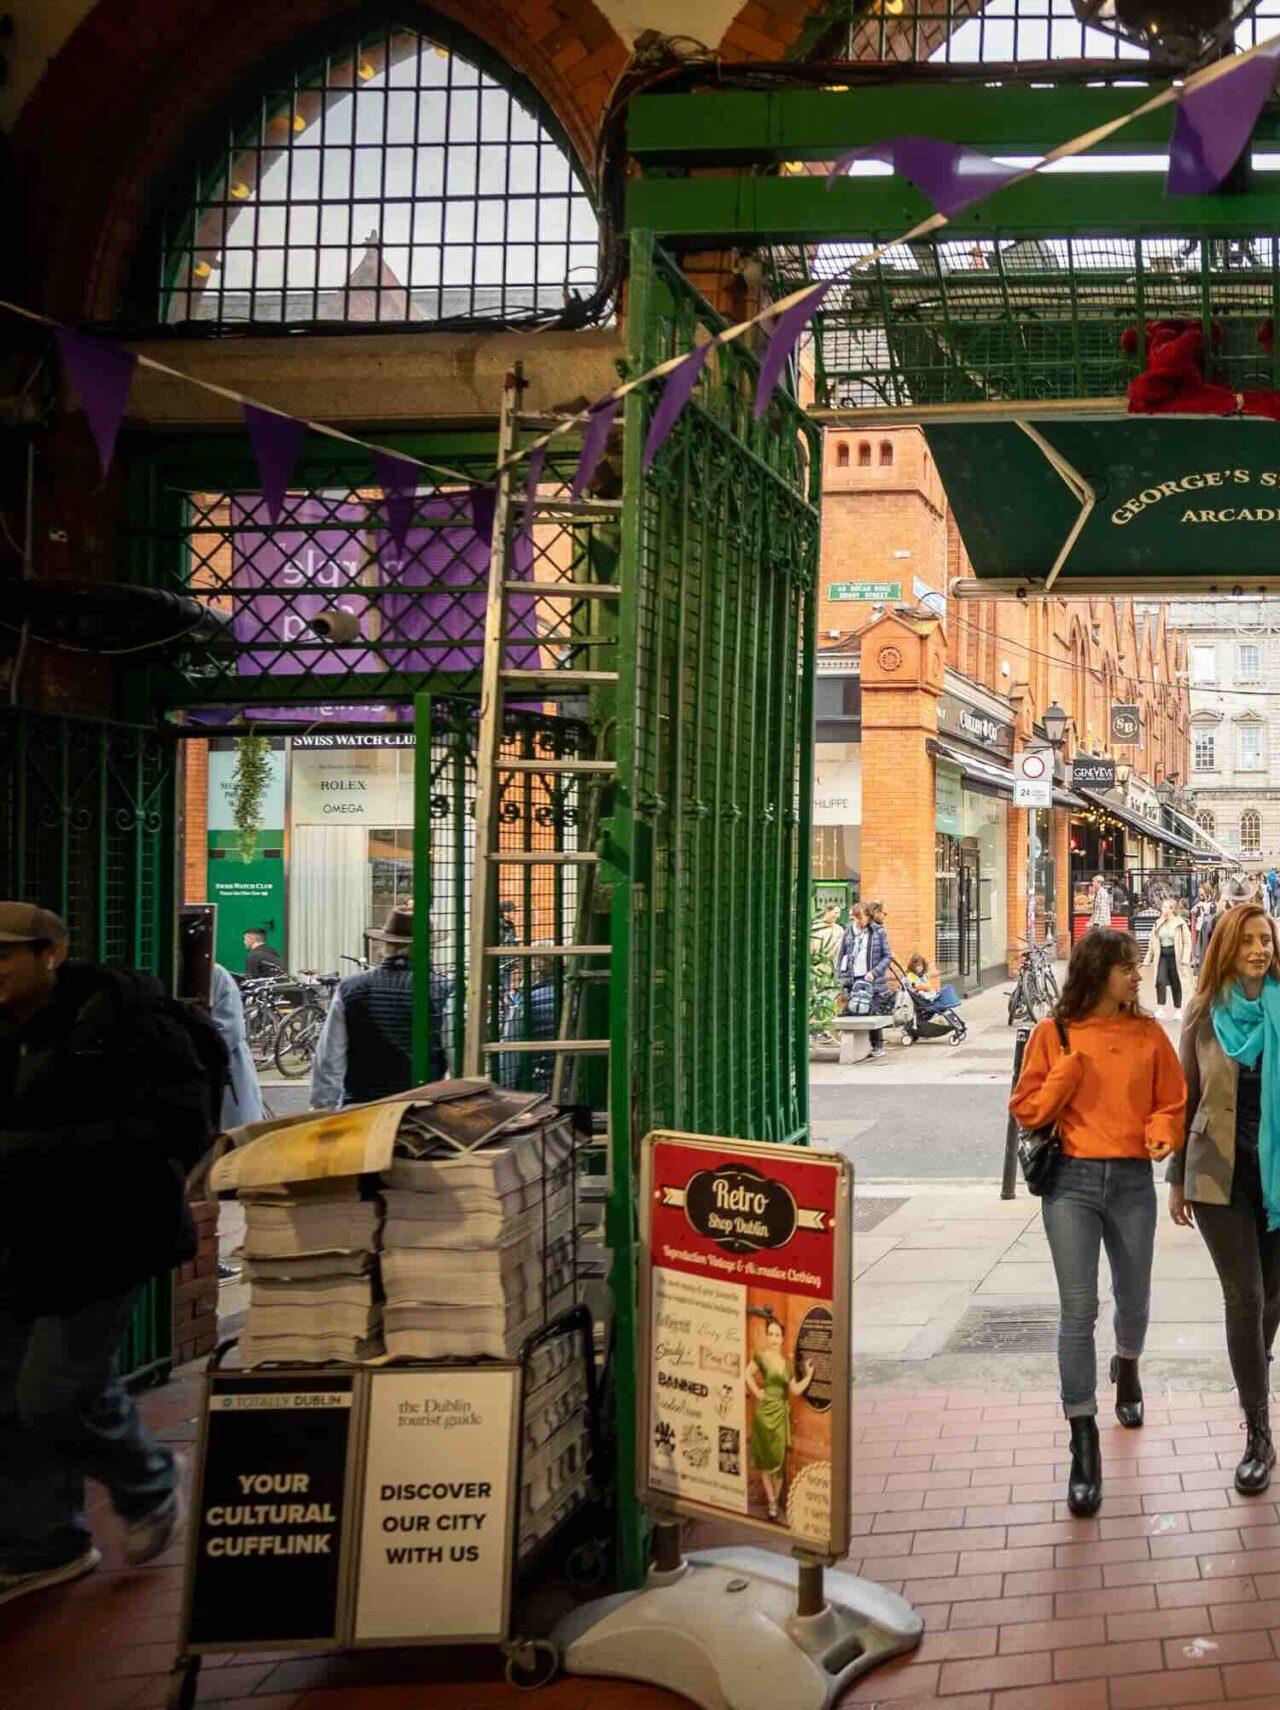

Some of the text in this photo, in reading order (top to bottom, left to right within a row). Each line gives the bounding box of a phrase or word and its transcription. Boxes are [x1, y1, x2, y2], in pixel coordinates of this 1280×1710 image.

[1110, 469, 1250, 525] GEORGE'S
[1116, 718, 1133, 733] SB
[293, 735, 333, 746] SWISS
[335, 735, 382, 746] WATCH
[320, 780, 368, 791] ROLEX
[1020, 788, 1030, 797] 24
[323, 803, 365, 814] OMEGA
[712, 1178, 769, 1215] Retro
[708, 1213, 770, 1238] Shop Dublin
[787, 1268, 823, 1290] Clothing
[657, 1371, 709, 1399] BANNED
[237, 1394, 342, 1408] TOTALLY DUBLIN
[398, 1399, 472, 1414] the Dublin
[398, 1412, 483, 1428] tourist guide
[239, 1473, 310, 1494] YOUR
[380, 1481, 492, 1502] DISCOVER
[206, 1504, 336, 1527] CULTURAL
[382, 1513, 487, 1533] OUR CITY
[206, 1534, 331, 1558] CUFFLINK
[386, 1545, 480, 1565] WITH US
